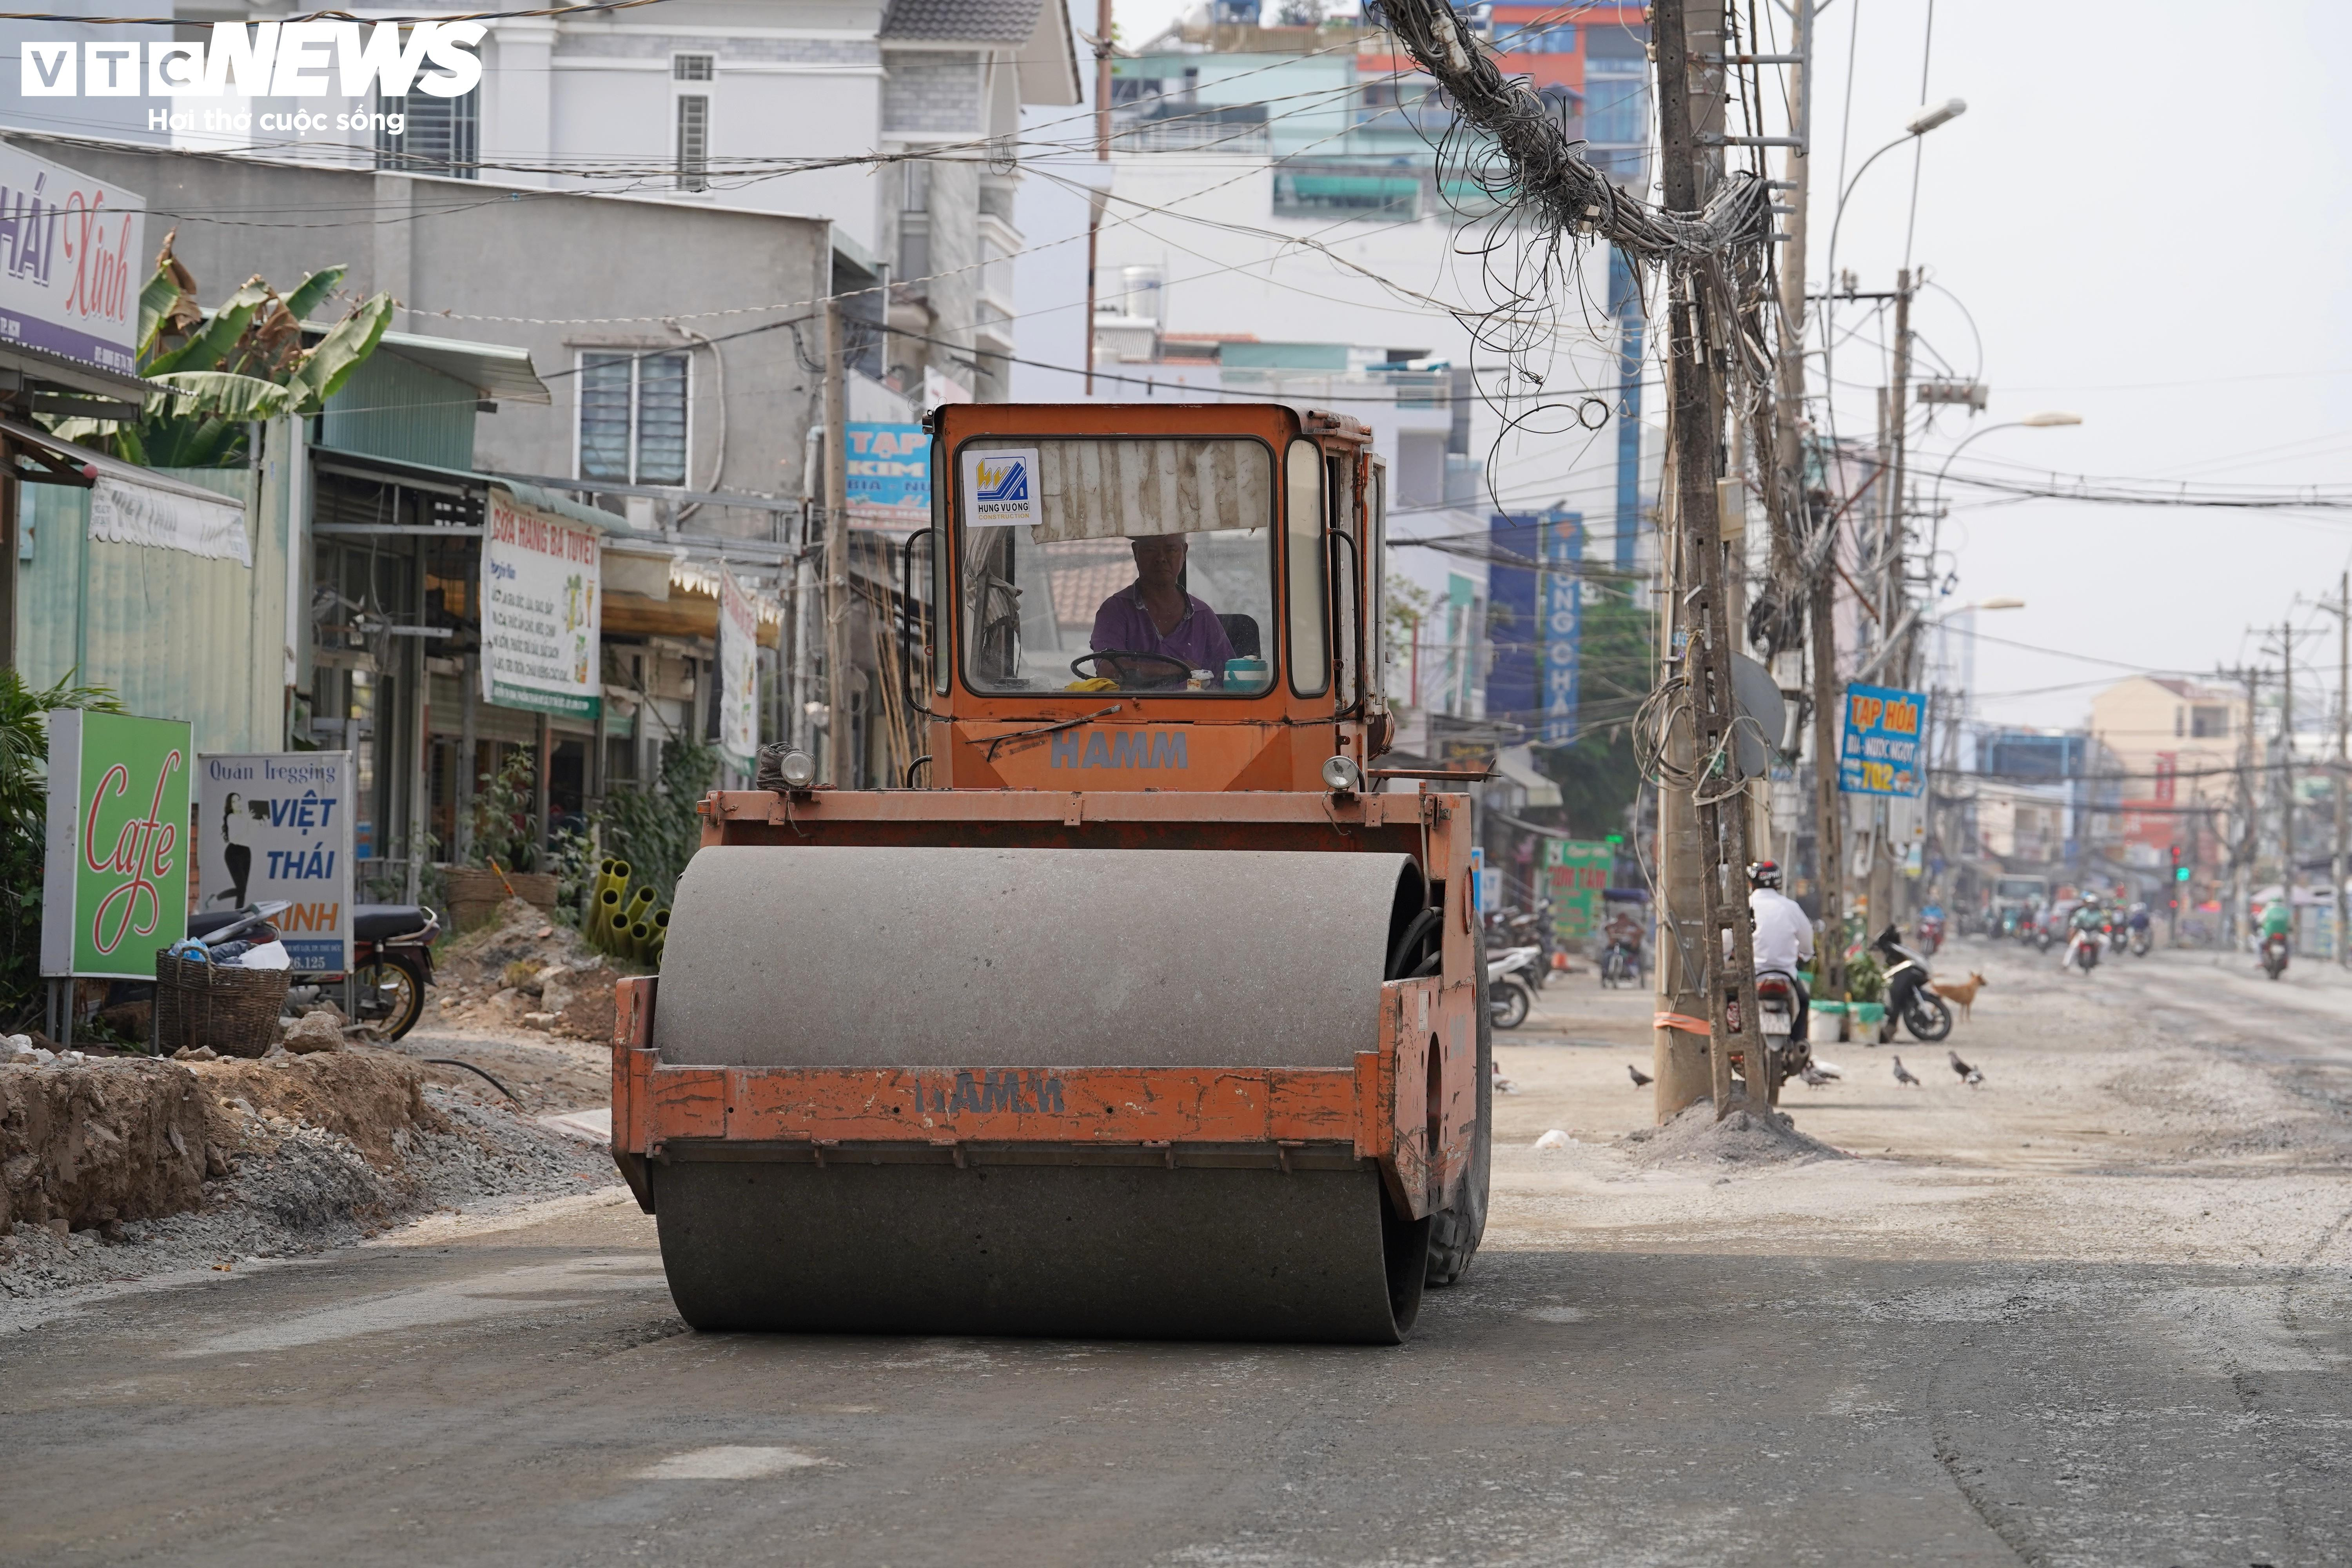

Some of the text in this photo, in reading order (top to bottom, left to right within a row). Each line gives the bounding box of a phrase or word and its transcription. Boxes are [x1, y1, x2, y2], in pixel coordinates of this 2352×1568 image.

[64, 190, 131, 321] Xinh
[849, 431, 928, 459] TẠP
[847, 460, 925, 477] KIM
[848, 479, 881, 490] BIA
[978, 503, 1028, 512] HUNG VUONG
[1852, 694, 1918, 735] TẠP HÓA
[1050, 731, 1188, 769] HAMM
[263, 759, 335, 784] Tregging
[1862, 761, 1893, 790] 702
[271, 789, 336, 835] VIỆT
[86, 750, 181, 955] Cafe
[267, 841, 335, 879] THÁI
